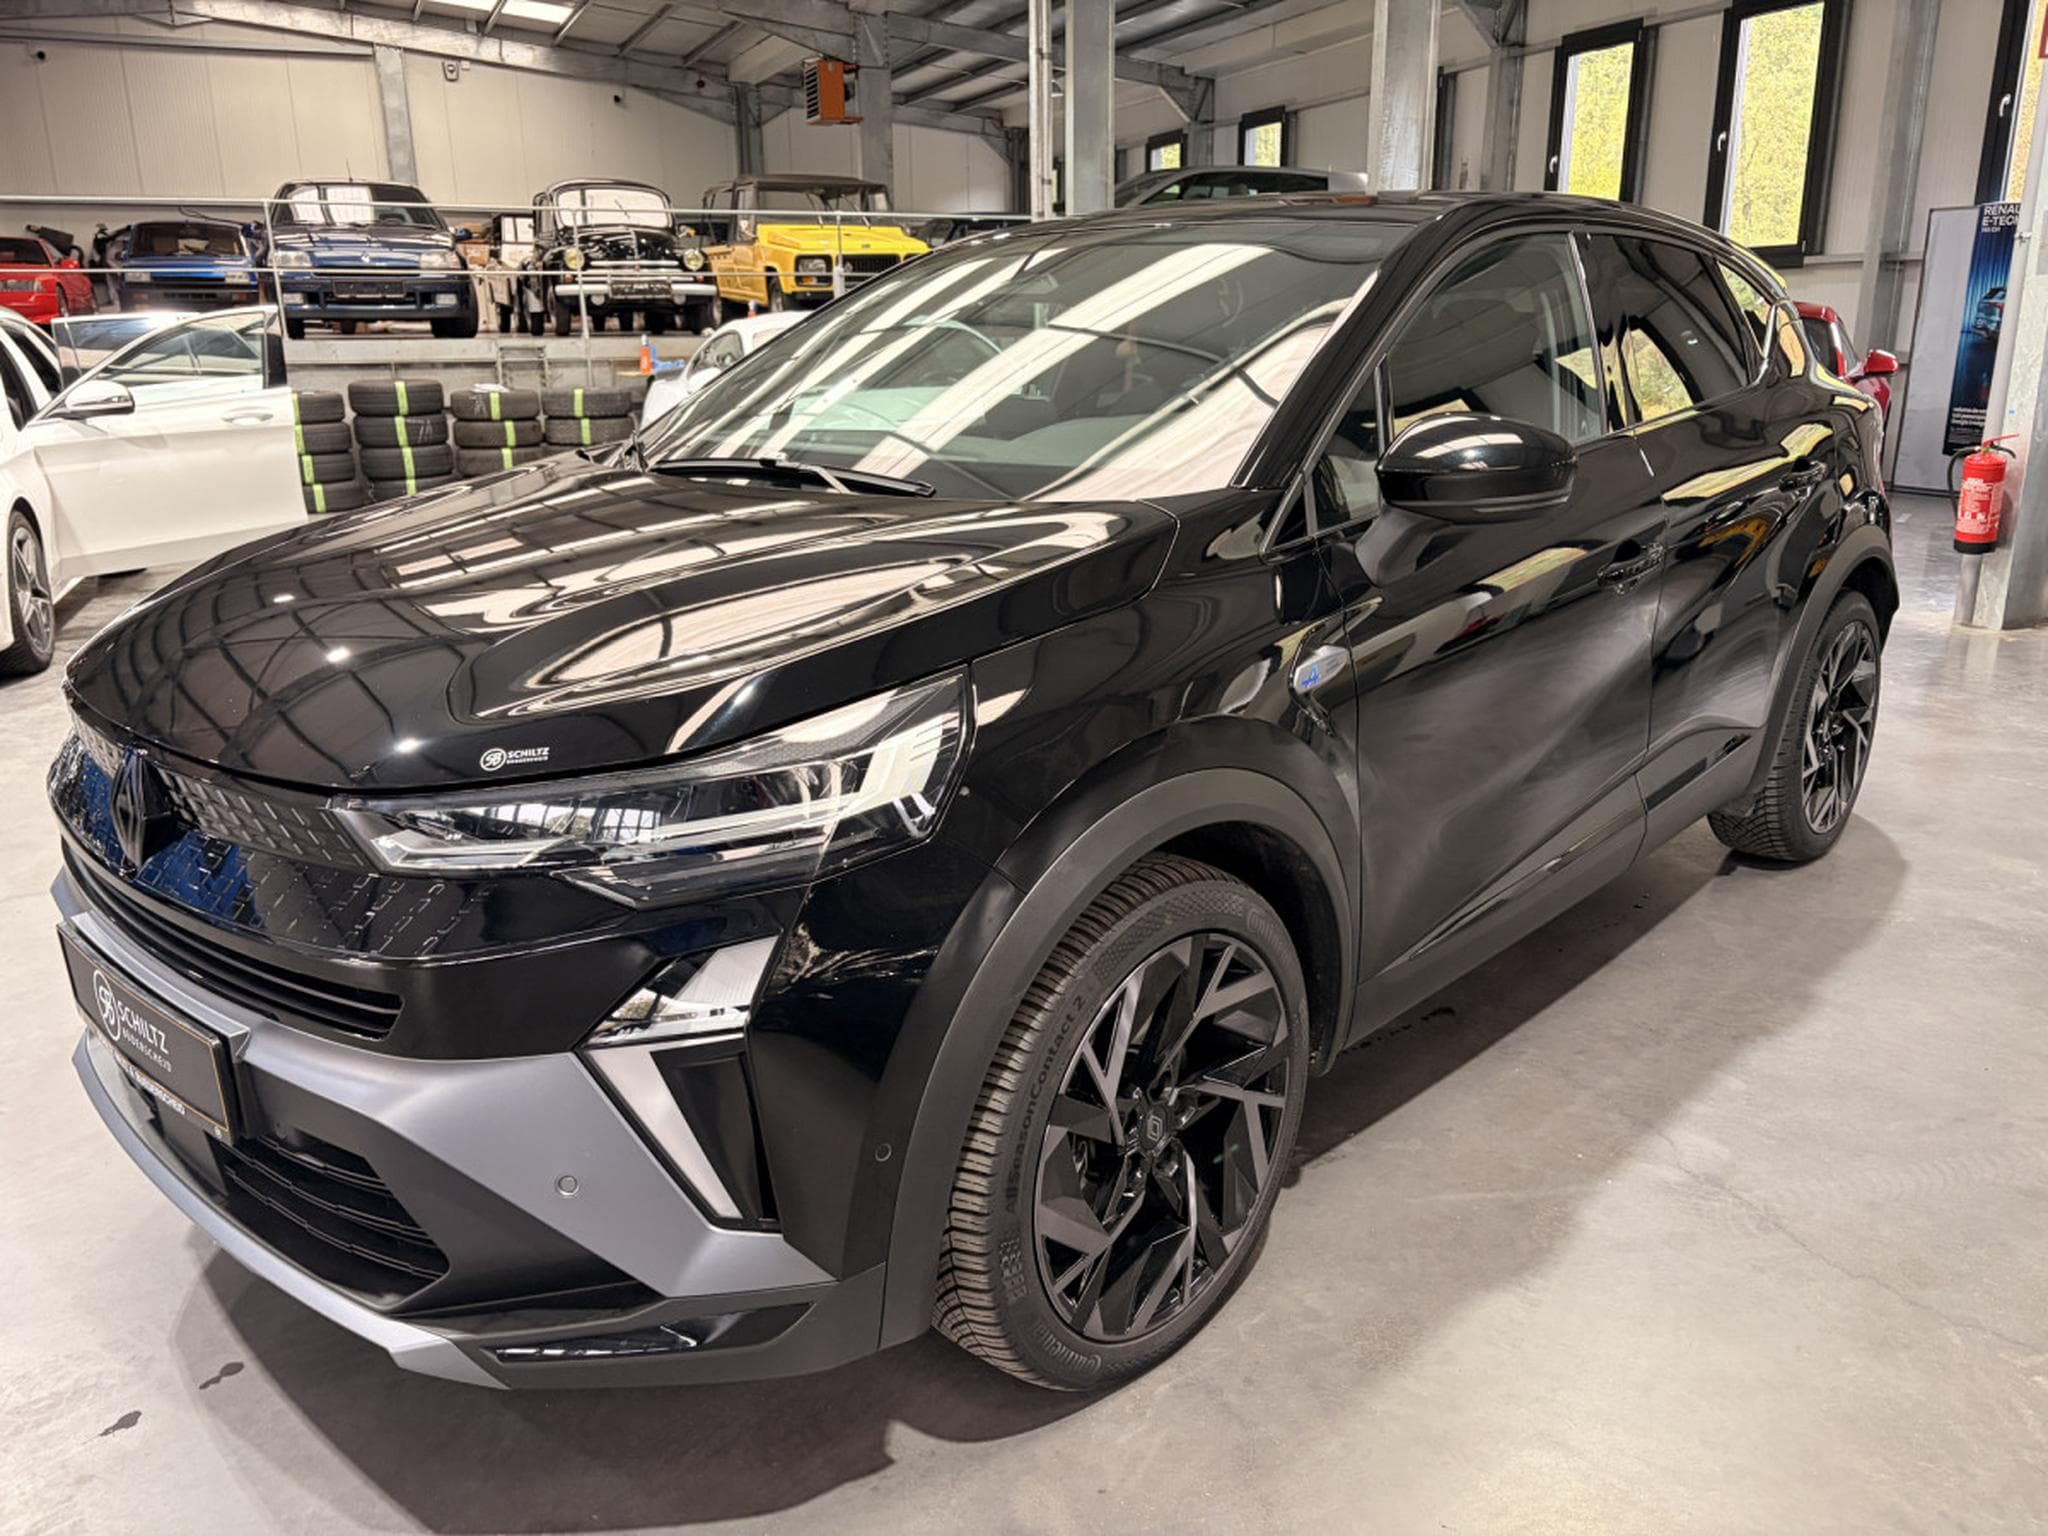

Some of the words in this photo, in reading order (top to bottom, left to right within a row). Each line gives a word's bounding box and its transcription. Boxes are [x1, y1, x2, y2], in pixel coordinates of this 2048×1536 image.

[507, 746, 550, 759] SCHILTZ
[117, 1000, 169, 1054] SCHILTZ
[1005, 1014, 1077, 1214] AllSeasonContact
